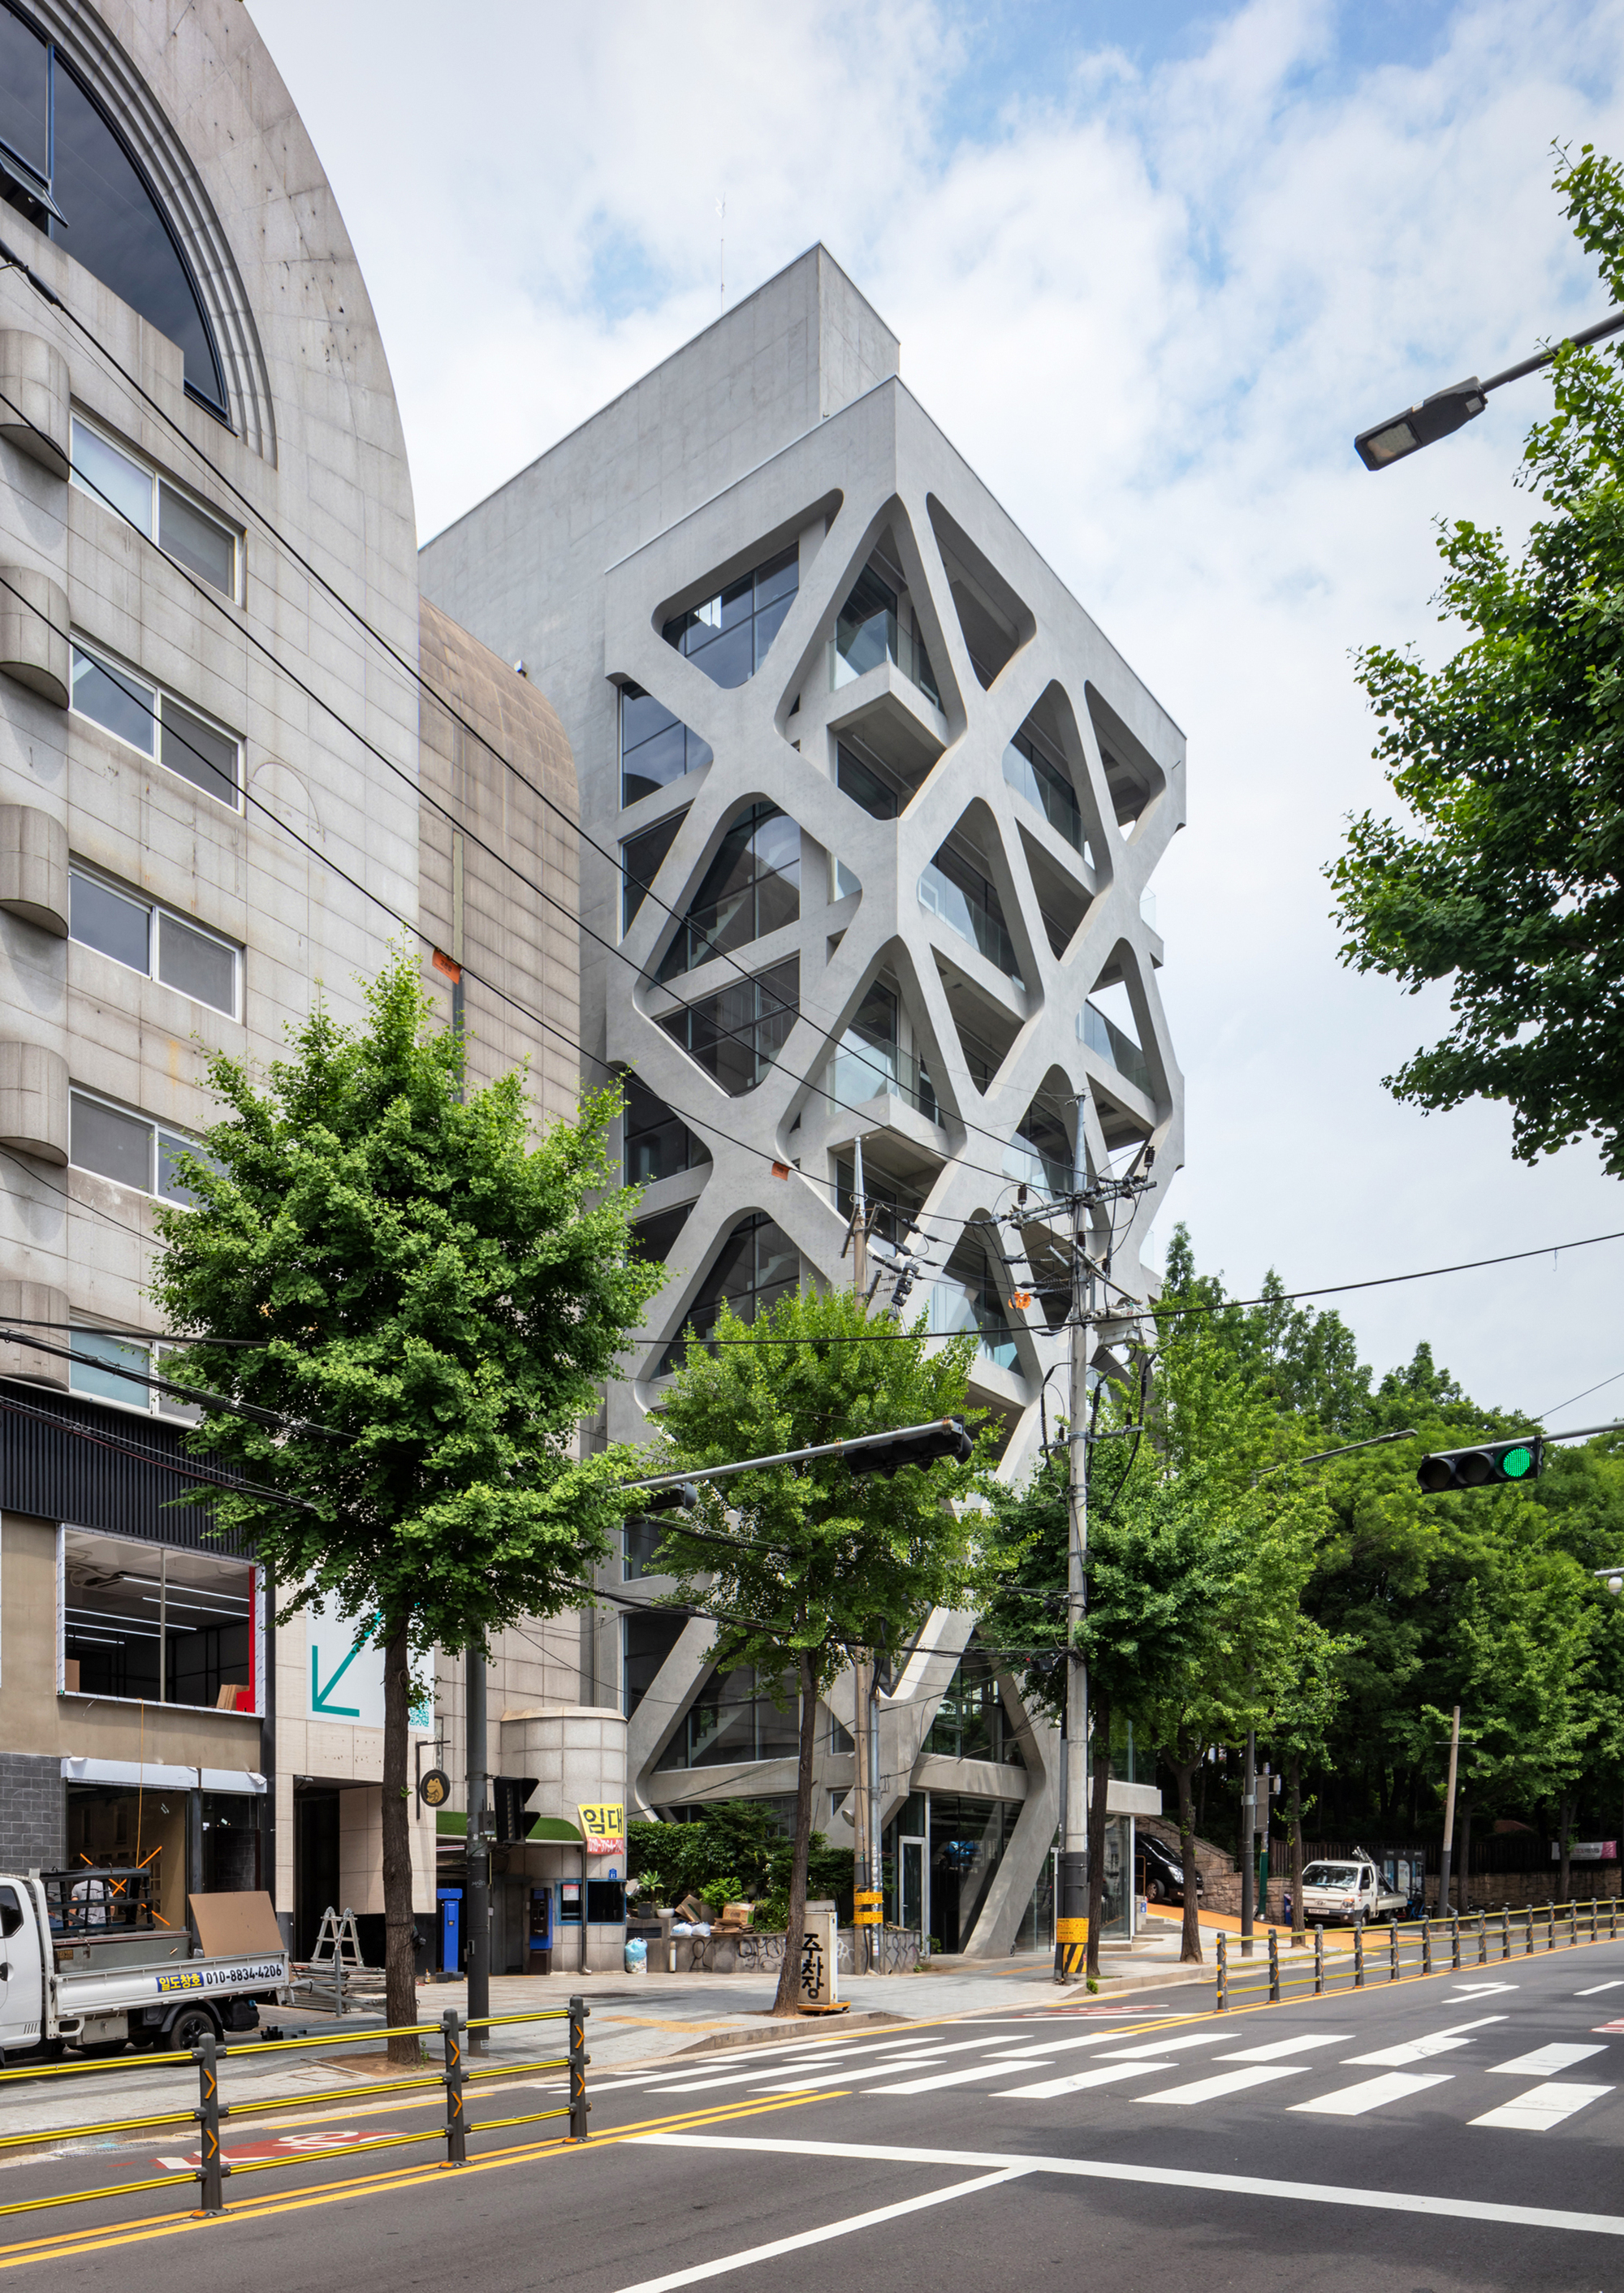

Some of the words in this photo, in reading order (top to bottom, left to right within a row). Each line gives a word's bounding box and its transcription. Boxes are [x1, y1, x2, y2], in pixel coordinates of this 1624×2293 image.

[583, 1807, 623, 1833] 임대
[801, 1933, 825, 1999] 주차장
[158, 1973, 202, 1991] 일도창호
